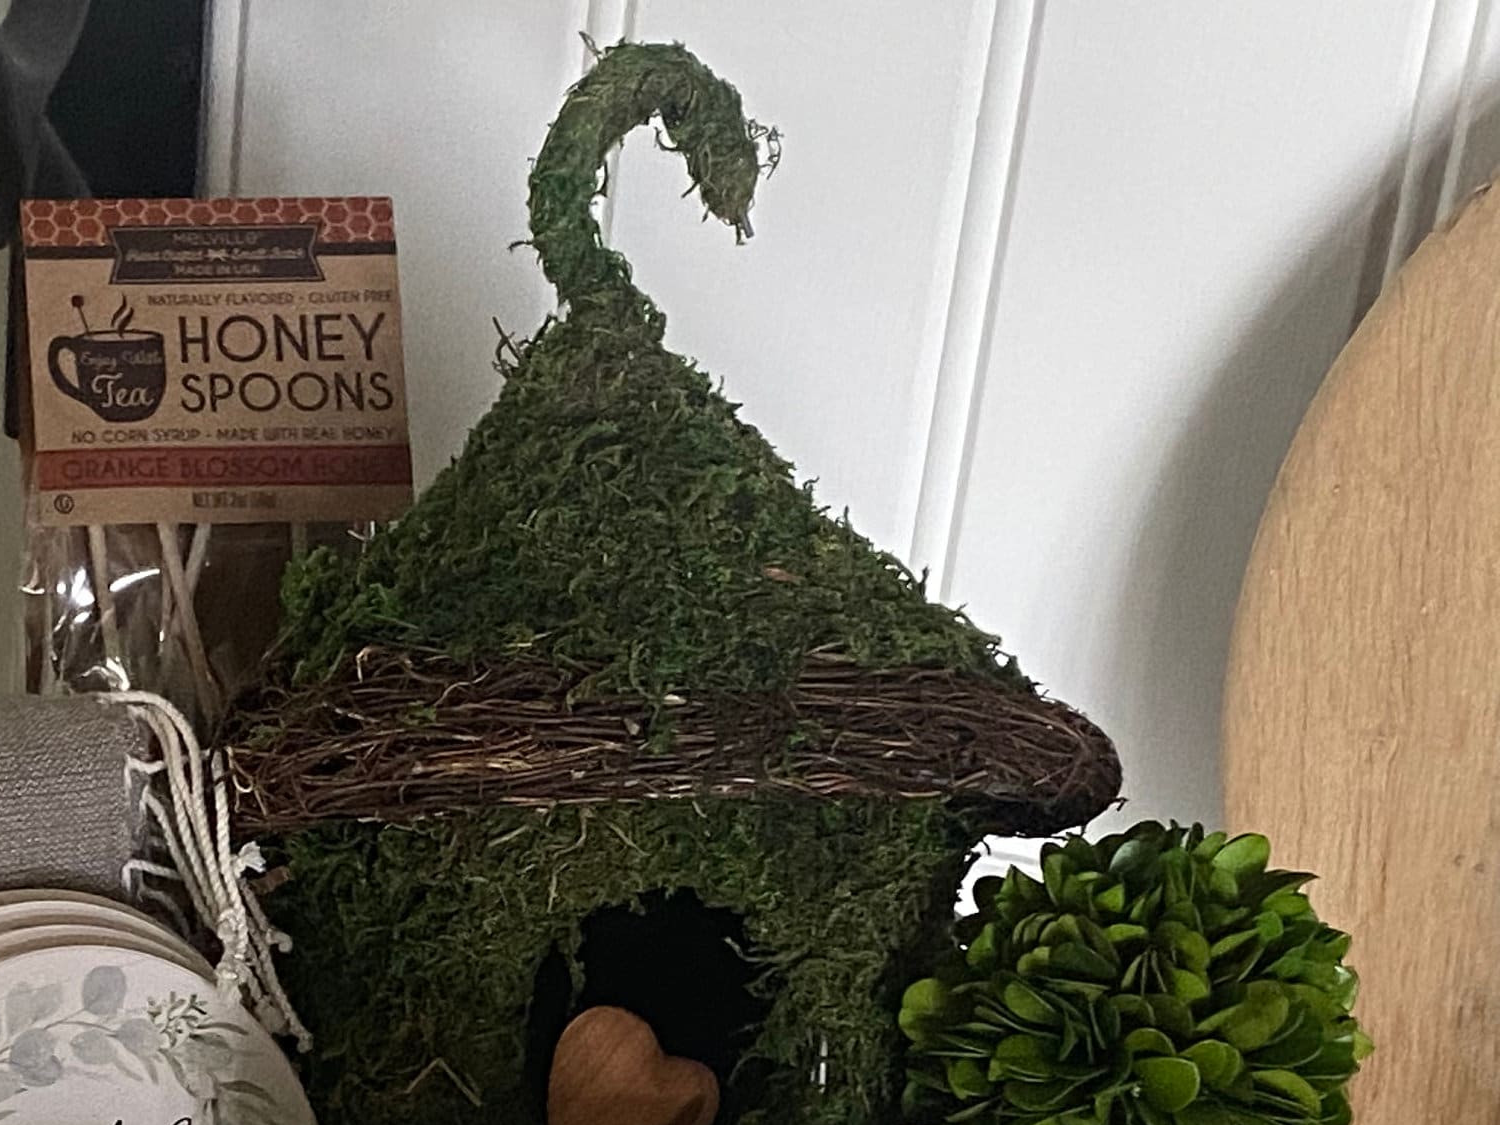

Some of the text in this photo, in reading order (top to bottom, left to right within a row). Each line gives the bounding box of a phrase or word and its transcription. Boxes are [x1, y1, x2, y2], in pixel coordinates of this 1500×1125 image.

[148, 294, 220, 306] NATURALLY
[308, 290, 360, 304] GLUTEN
[364, 289, 391, 302] FREE
[179, 312, 386, 363] HONEY
[91, 373, 155, 408] Tea
[181, 371, 394, 413] SPOONS
[71, 427, 396, 444] NO CORN SYRUP MADE WITH REAL HONEY
[62, 456, 169, 480] ORANGE
[180, 455, 302, 478] BLOSSOM
